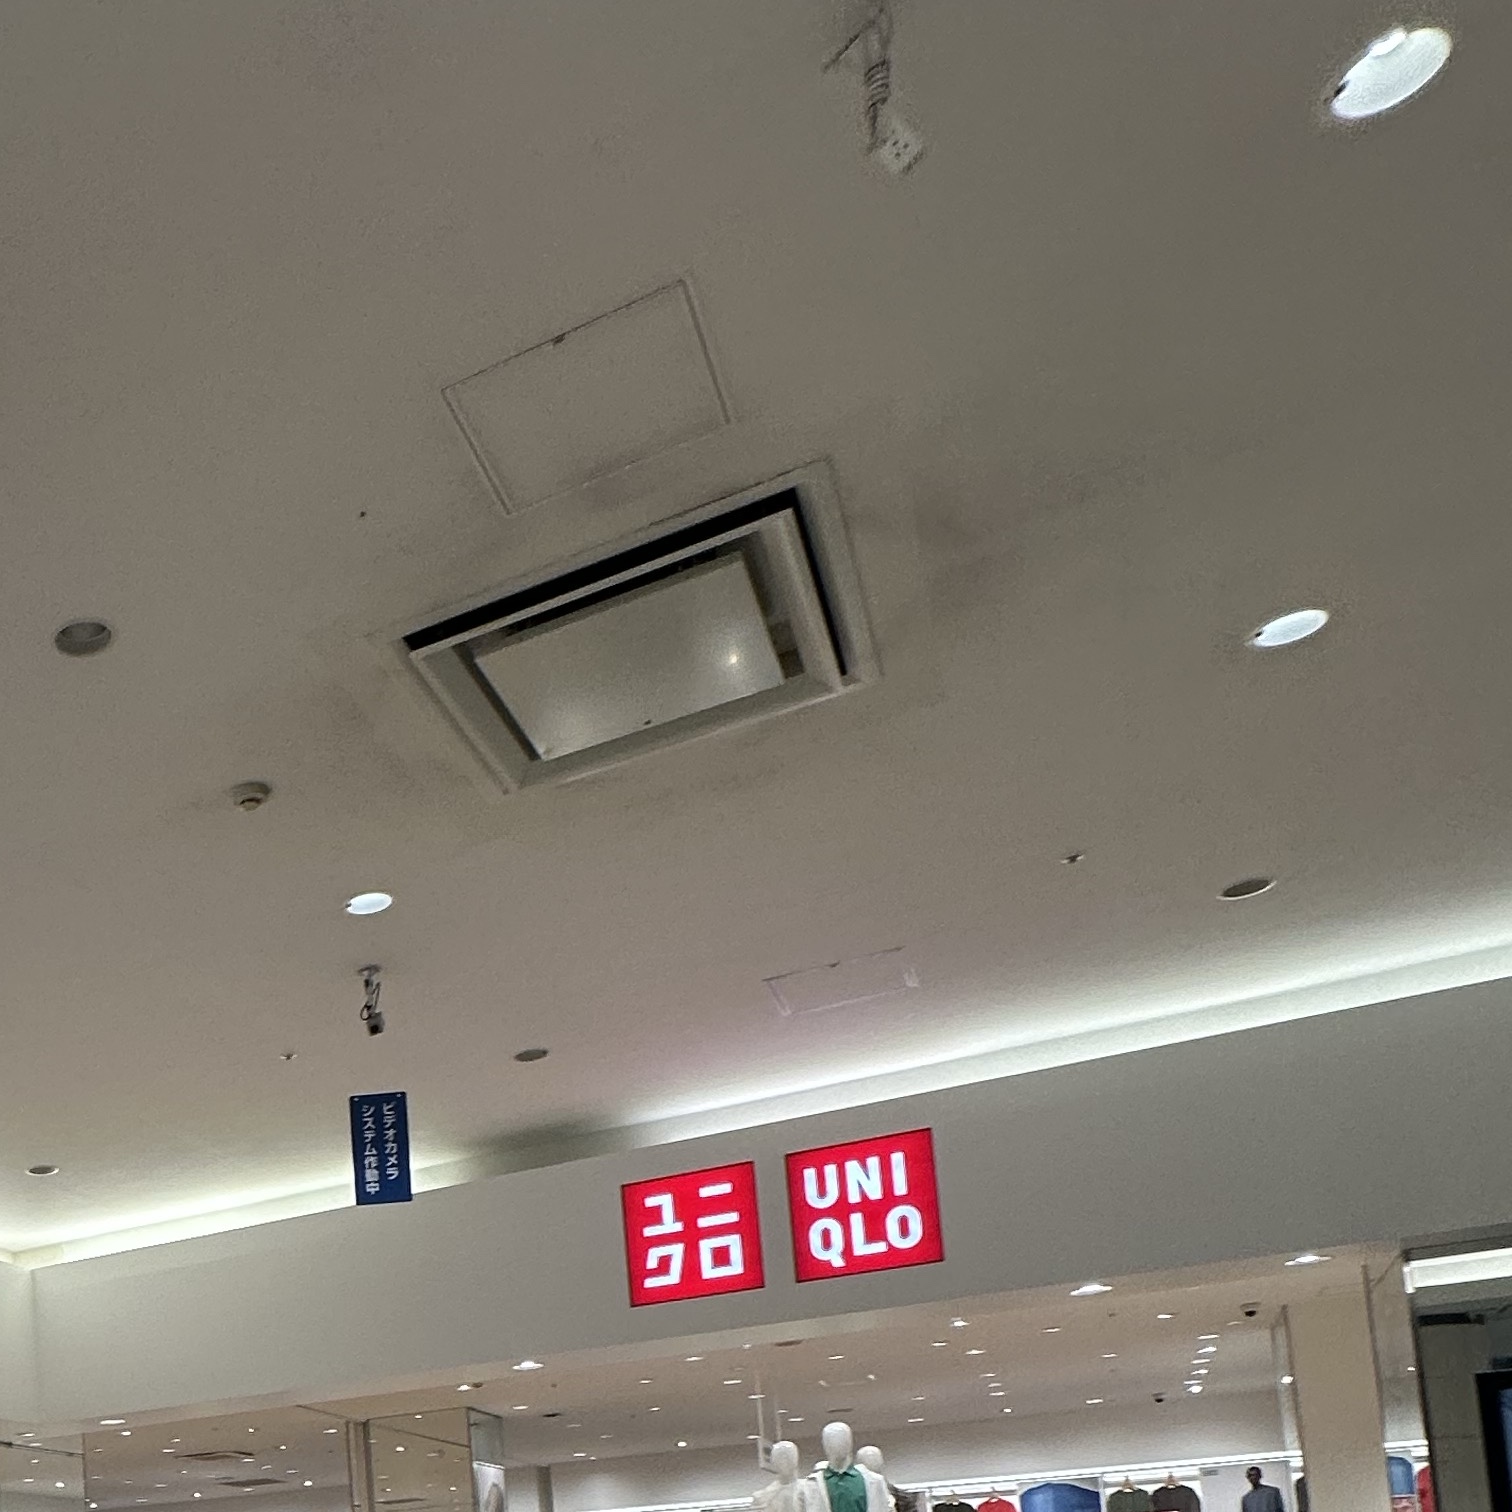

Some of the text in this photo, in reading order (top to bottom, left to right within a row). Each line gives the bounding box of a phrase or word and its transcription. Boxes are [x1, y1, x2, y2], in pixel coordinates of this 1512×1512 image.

[803, 1151, 908, 1209] UNI
[643, 1182, 740, 1237] ユニ
[808, 1205, 923, 1267] QLO
[643, 1234, 744, 1288] クロ
